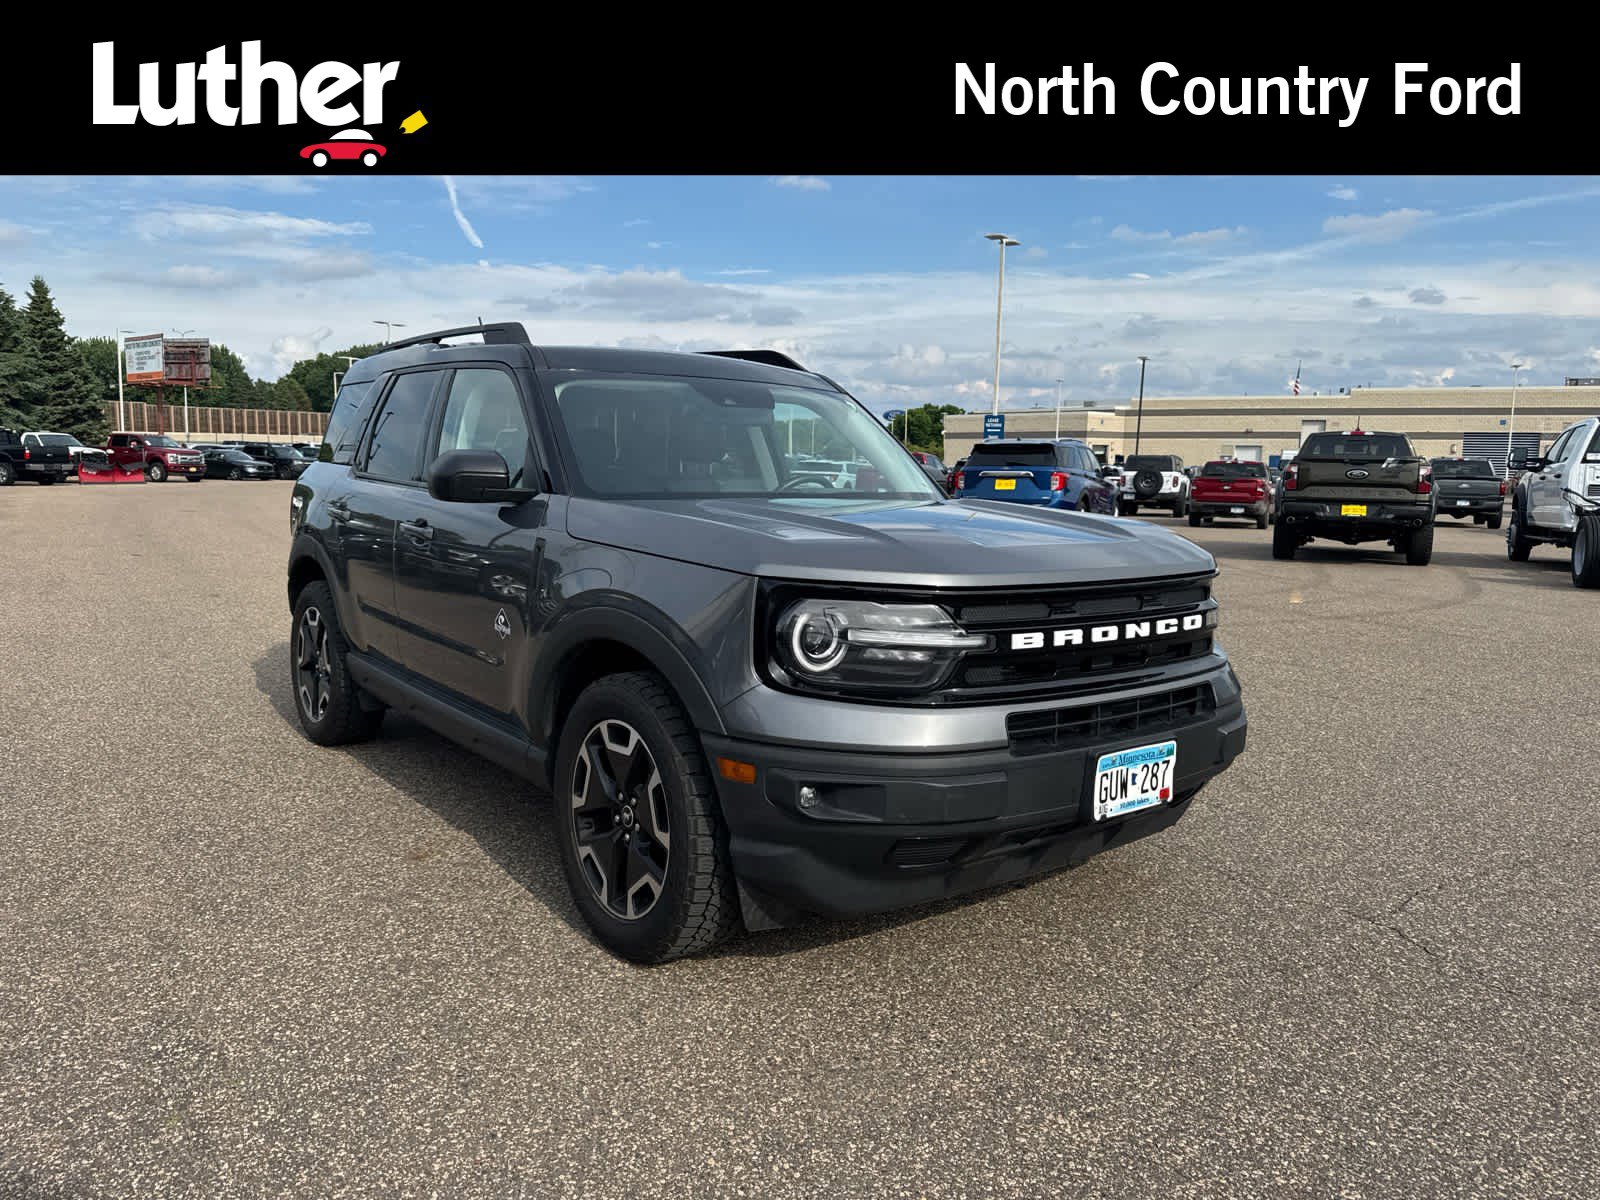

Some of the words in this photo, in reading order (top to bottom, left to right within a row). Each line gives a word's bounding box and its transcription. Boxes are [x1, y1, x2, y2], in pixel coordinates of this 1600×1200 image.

[1011, 614, 1205, 650] BRONCO
[1118, 751, 1156, 766] Minnesota
[1099, 768, 1129, 804] GUW
[1140, 759, 1171, 795] 287
